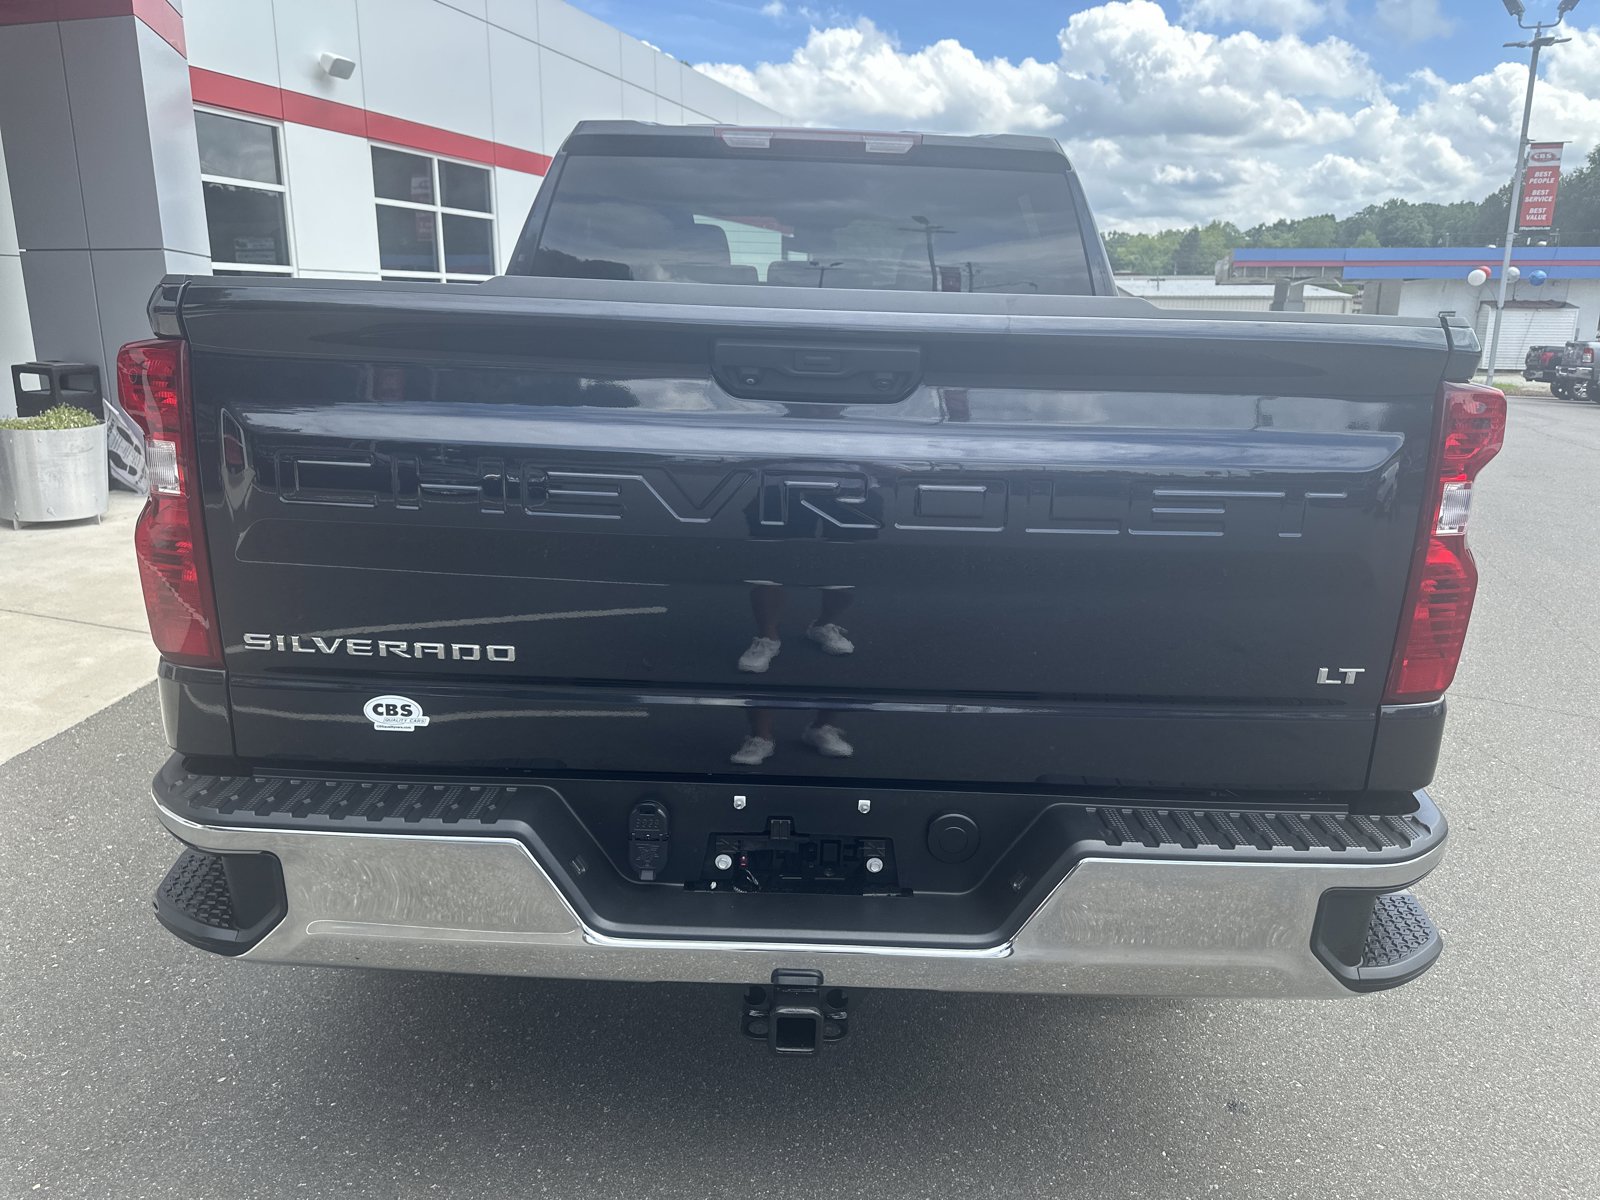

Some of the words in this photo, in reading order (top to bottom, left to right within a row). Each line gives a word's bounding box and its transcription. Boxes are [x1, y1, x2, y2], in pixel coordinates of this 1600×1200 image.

[275, 451, 1348, 538] CHEVROLET
[243, 633, 515, 662] SILVERADO
[1316, 667, 1366, 685] LT
[372, 703, 413, 717] CBS
